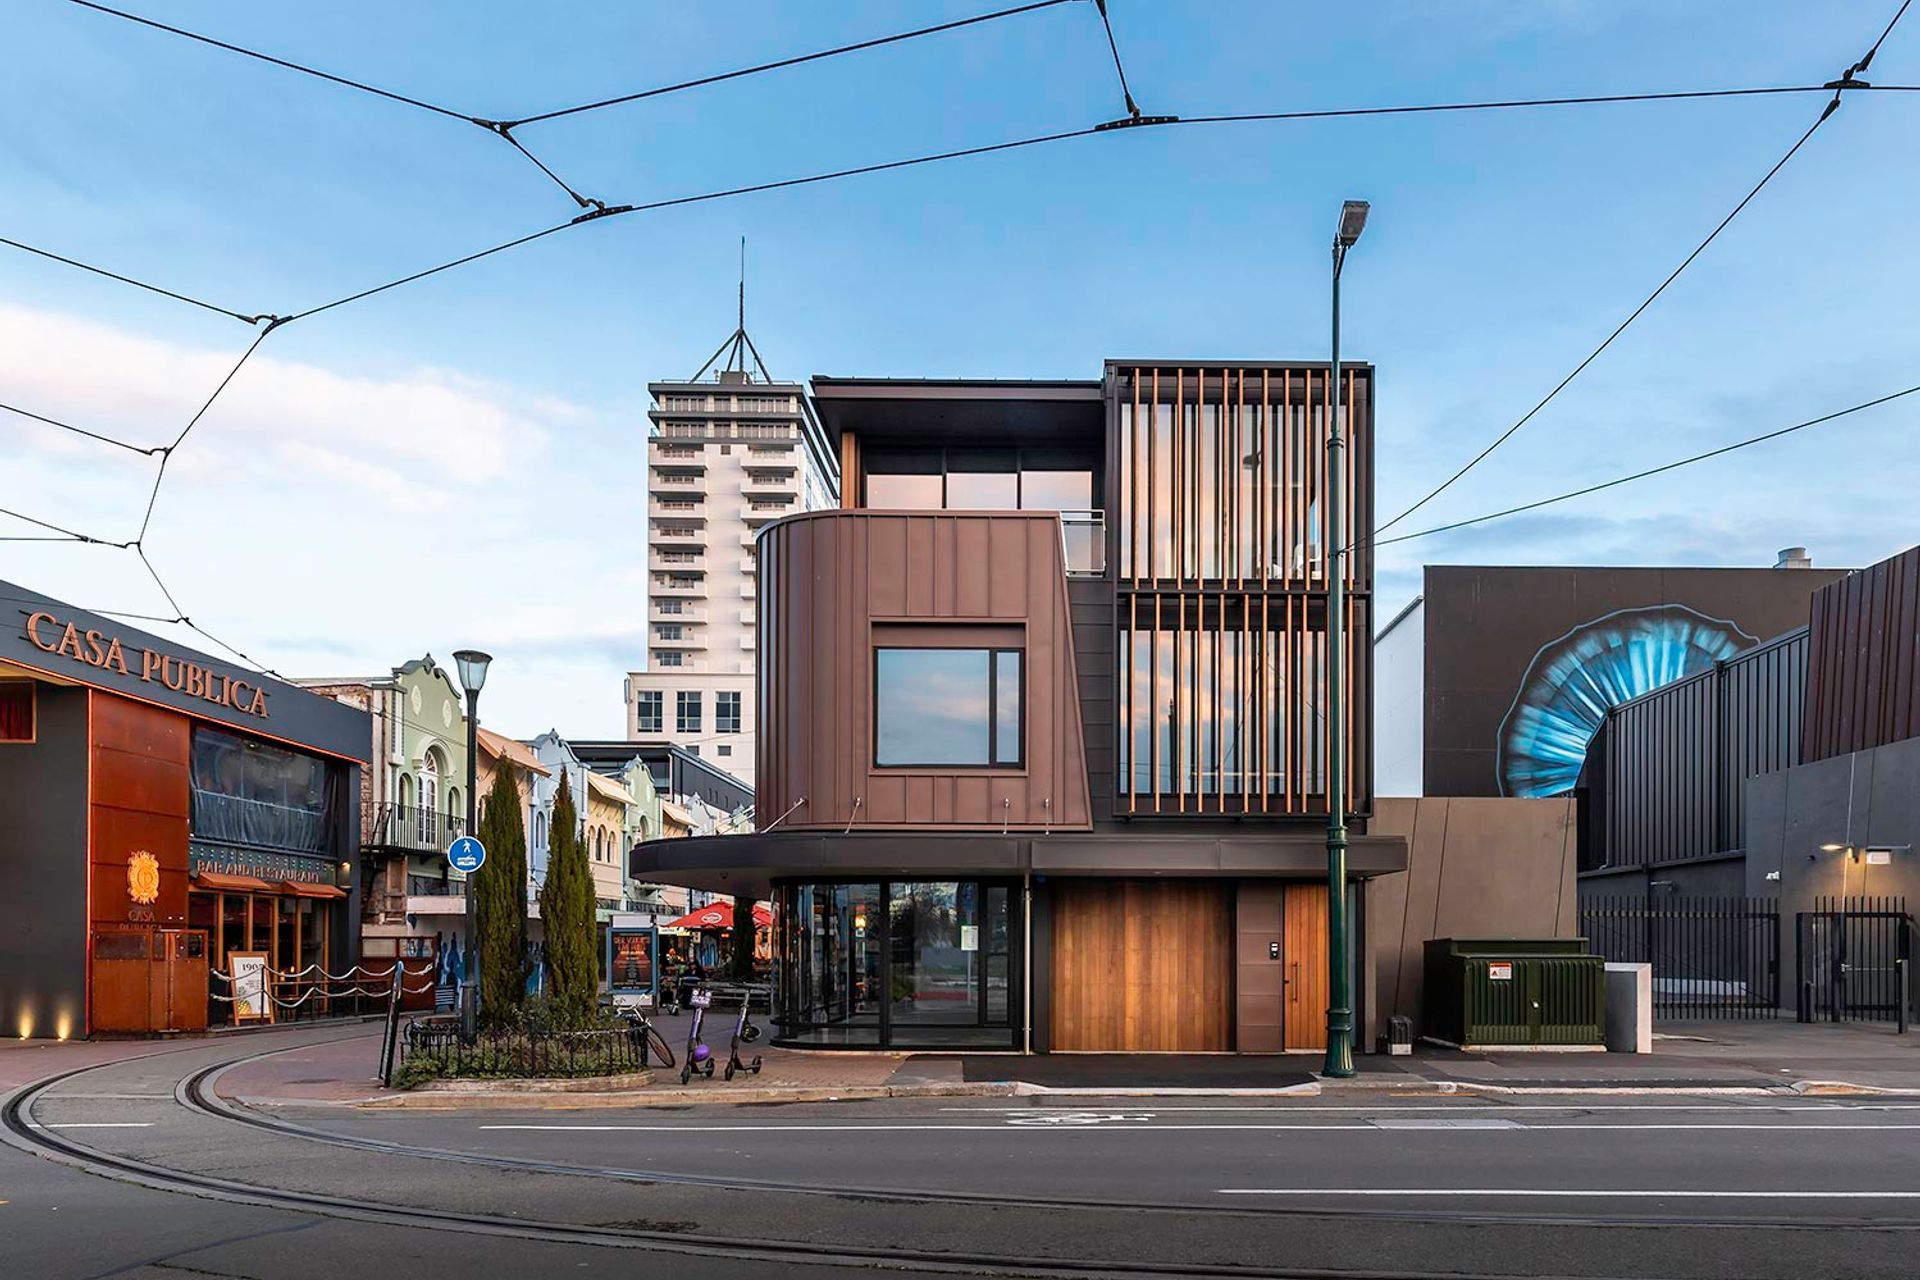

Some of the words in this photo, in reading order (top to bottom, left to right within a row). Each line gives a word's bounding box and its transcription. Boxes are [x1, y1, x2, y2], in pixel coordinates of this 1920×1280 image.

[27, 612, 128, 675] CASA
[142, 647, 268, 718] PUBLICA
[197, 859, 222, 873] BAR
[226, 863, 250, 876] AND
[253, 866, 319, 883] RESTAURANT
[128, 910, 155, 922] CASA
